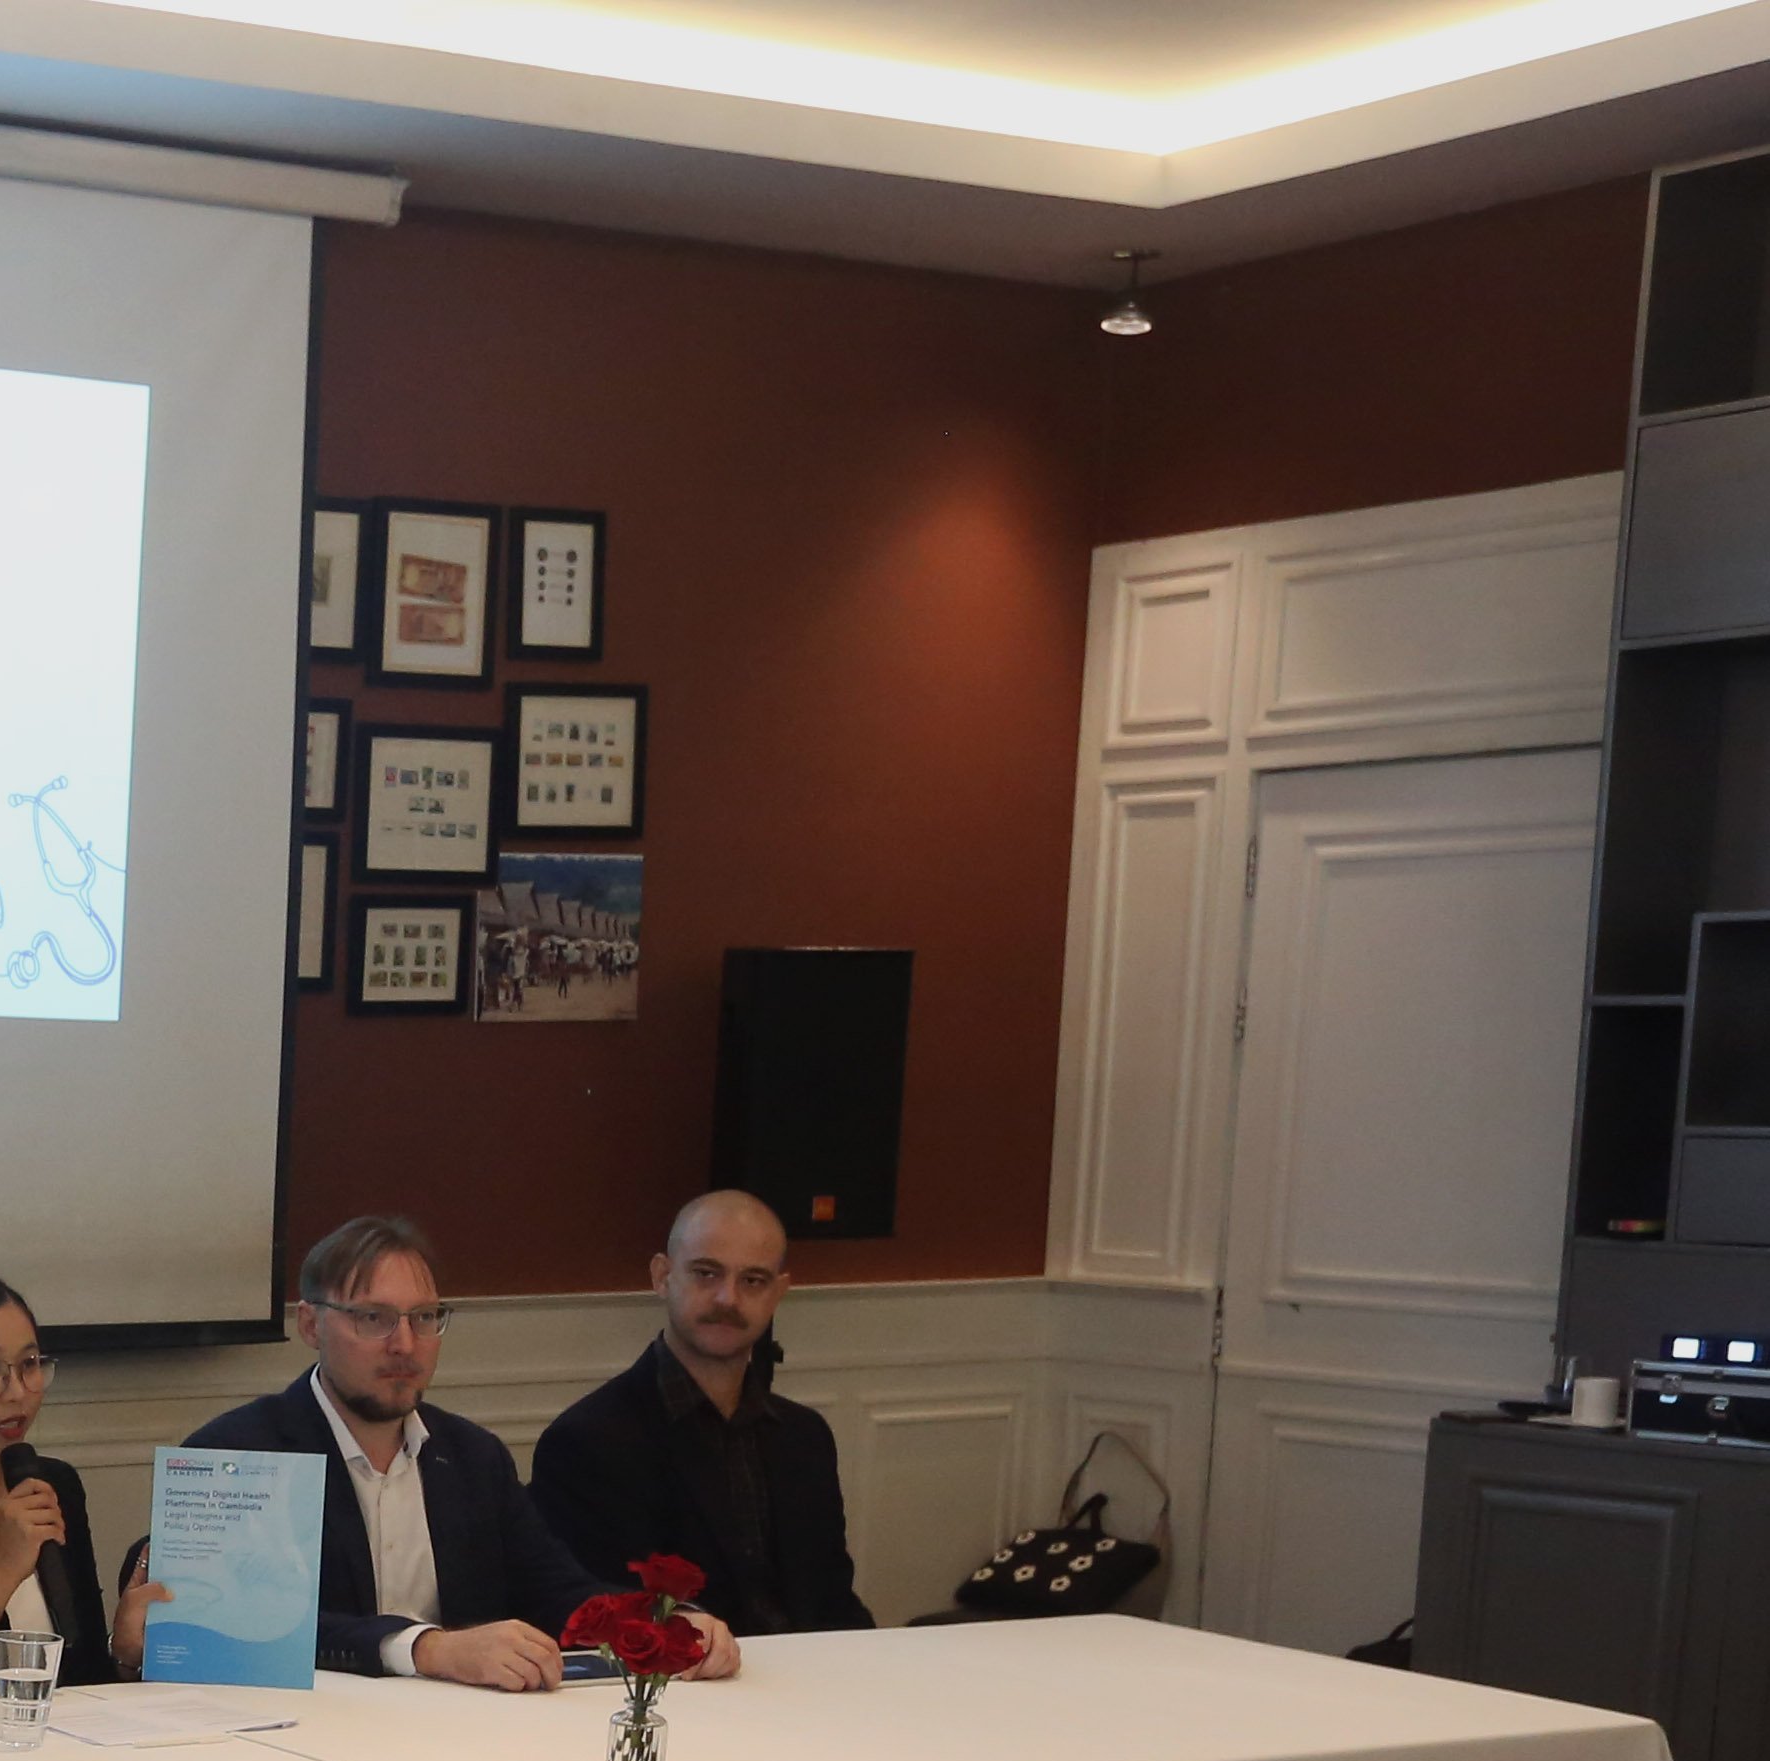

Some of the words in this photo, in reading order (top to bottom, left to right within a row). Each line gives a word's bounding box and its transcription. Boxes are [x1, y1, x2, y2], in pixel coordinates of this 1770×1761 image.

[164, 1488, 210, 1499] Governing
[212, 1490, 240, 1500] Digital
[242, 1492, 270, 1500] Health
[164, 1499, 206, 1509] Platforms
[219, 1501, 262, 1511] Cambodia
[164, 1511, 188, 1521] Legal
[225, 1513, 241, 1521] and
[164, 1522, 190, 1532] Policy
[191, 1523, 226, 1532] Options
